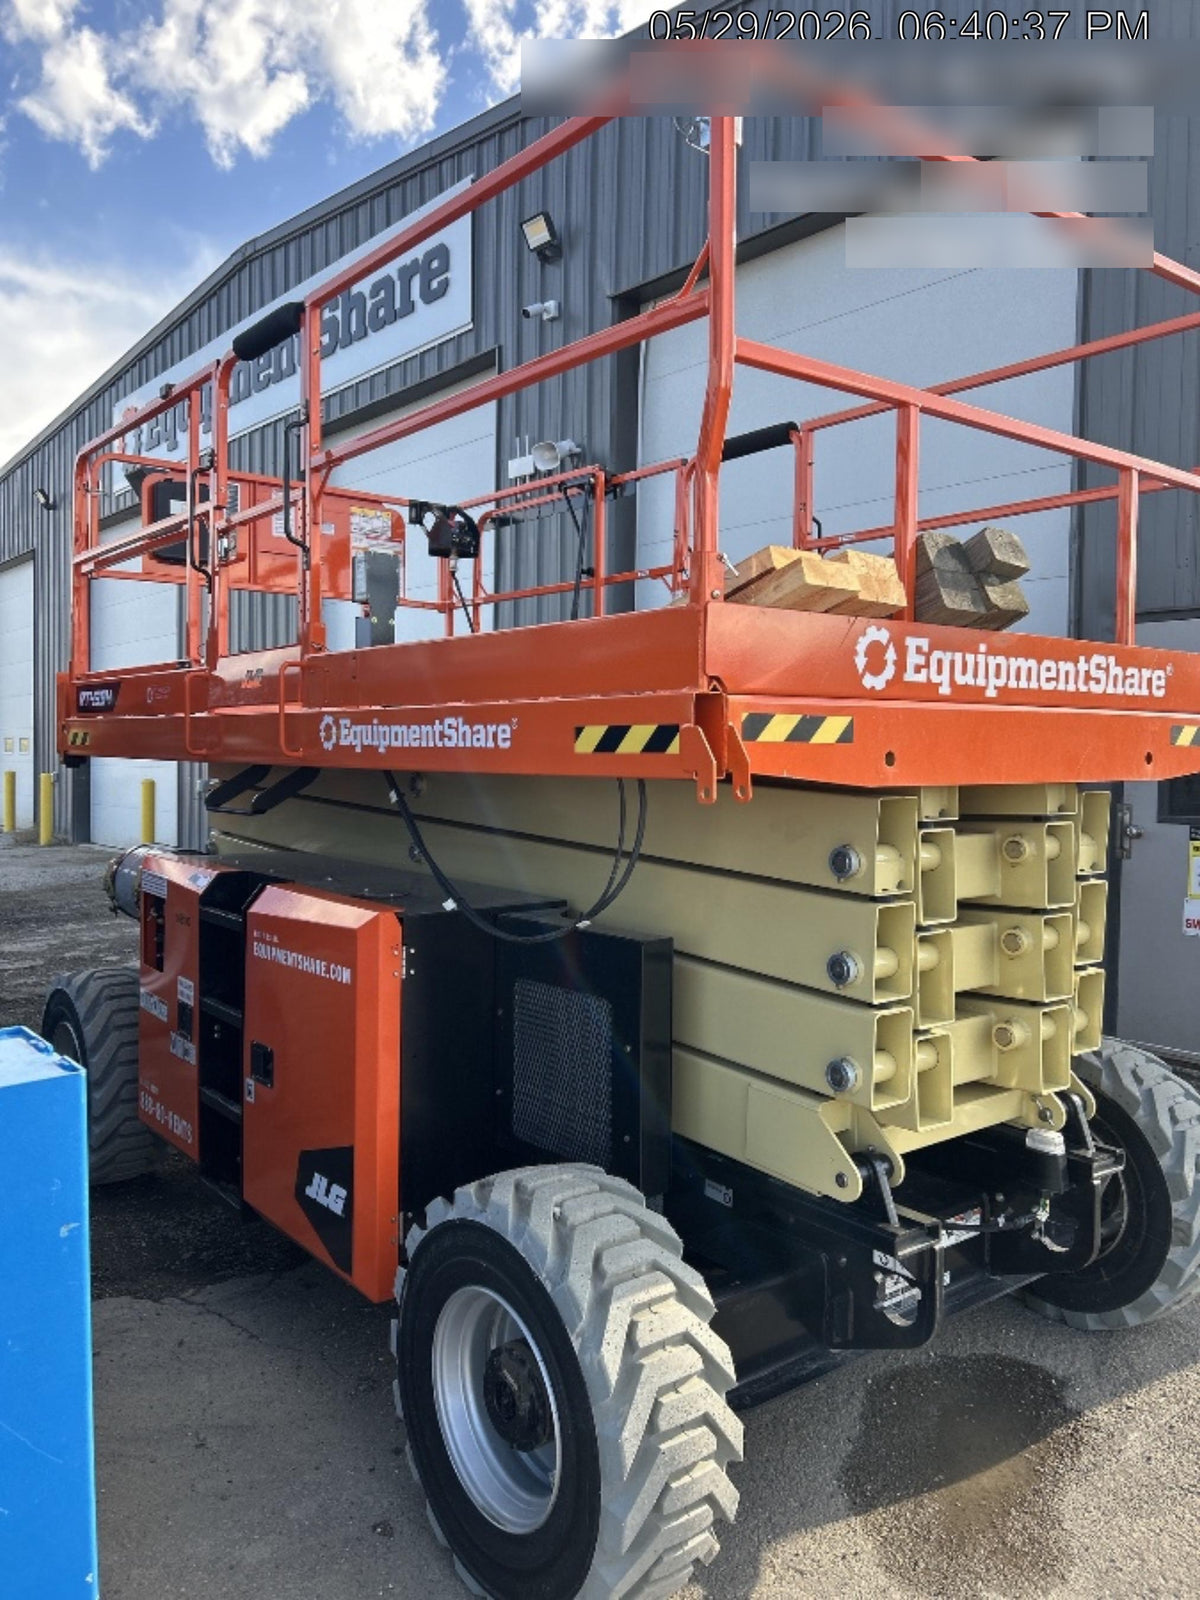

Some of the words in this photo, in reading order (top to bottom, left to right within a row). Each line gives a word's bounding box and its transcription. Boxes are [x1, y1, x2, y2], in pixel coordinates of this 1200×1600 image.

[903, 636, 1167, 698] EquipmentShare
[339, 717, 512, 753] EquipmentShare
[305, 1171, 347, 1217] JLG
